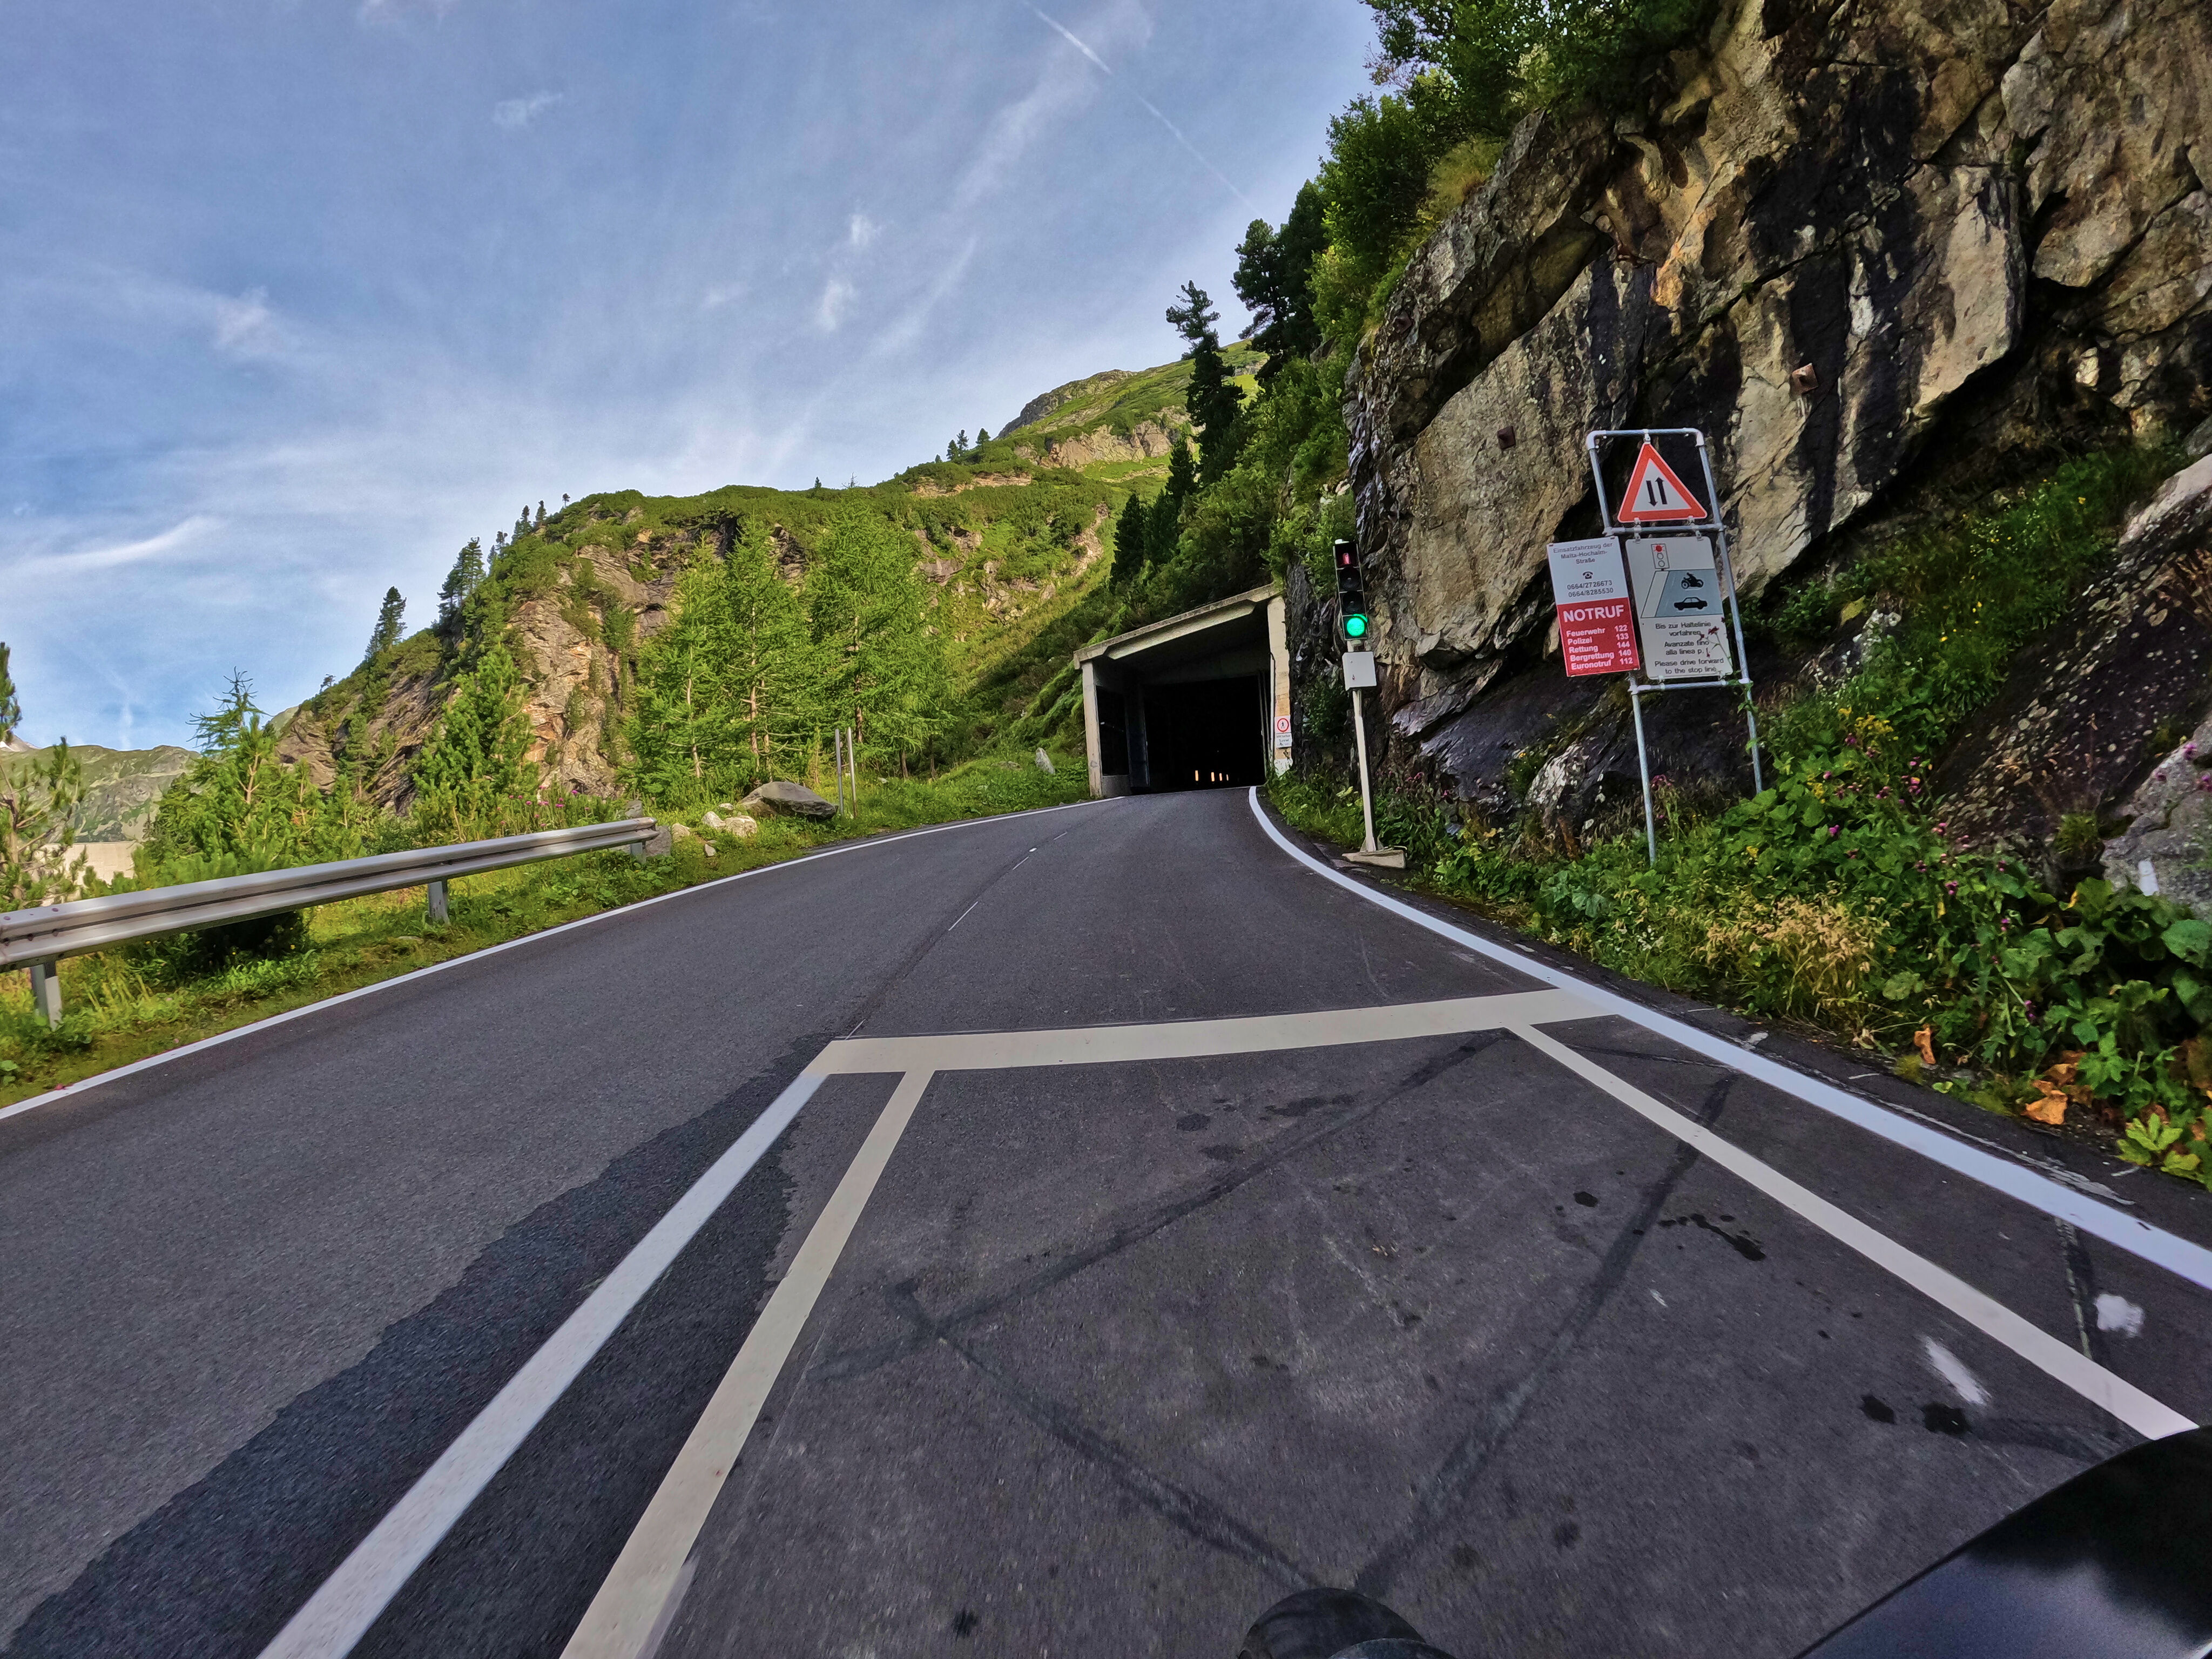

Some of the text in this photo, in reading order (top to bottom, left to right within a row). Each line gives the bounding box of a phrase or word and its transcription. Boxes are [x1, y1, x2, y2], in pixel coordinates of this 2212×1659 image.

[1553, 544, 1601, 553] Einsatzfahrzeug
[1561, 549, 1608, 559] Malta-Hochalm-
[1563, 604, 1624, 623] NOTRUF
[1566, 628, 1606, 637] Feuerwehr
[1568, 636, 1593, 645] Polizei
[1569, 645, 1599, 653] Rettung
[1570, 652, 1615, 662] Bergrettung
[1571, 659, 1611, 670] Euronotruf
